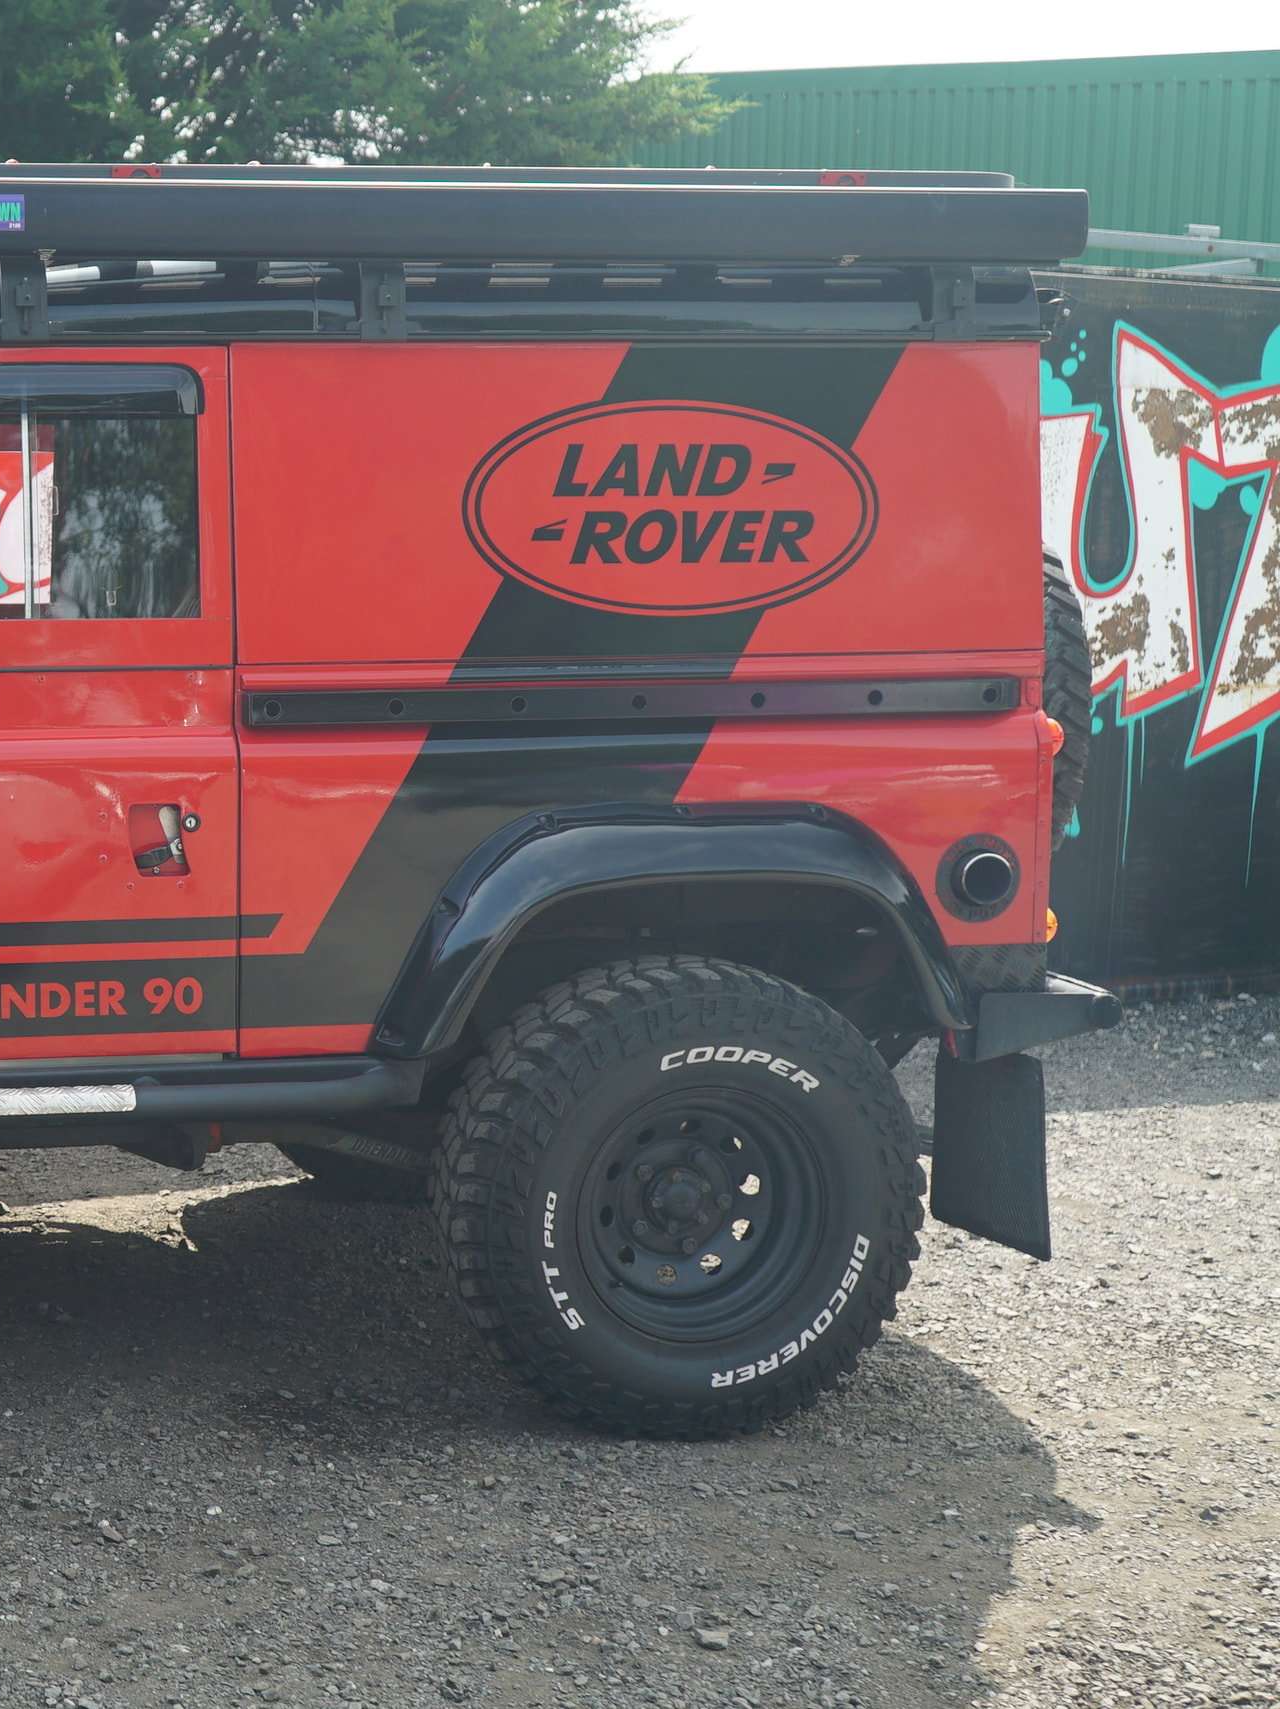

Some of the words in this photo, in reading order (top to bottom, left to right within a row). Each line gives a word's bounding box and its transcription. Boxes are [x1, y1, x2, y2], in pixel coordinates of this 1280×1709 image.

[143, 976, 203, 1016] 90
[659, 1046, 820, 1093] COOPER
[543, 1191, 558, 1249] PRO
[542, 1260, 586, 1331] STT
[711, 1233, 870, 1388] DISCOVERER
